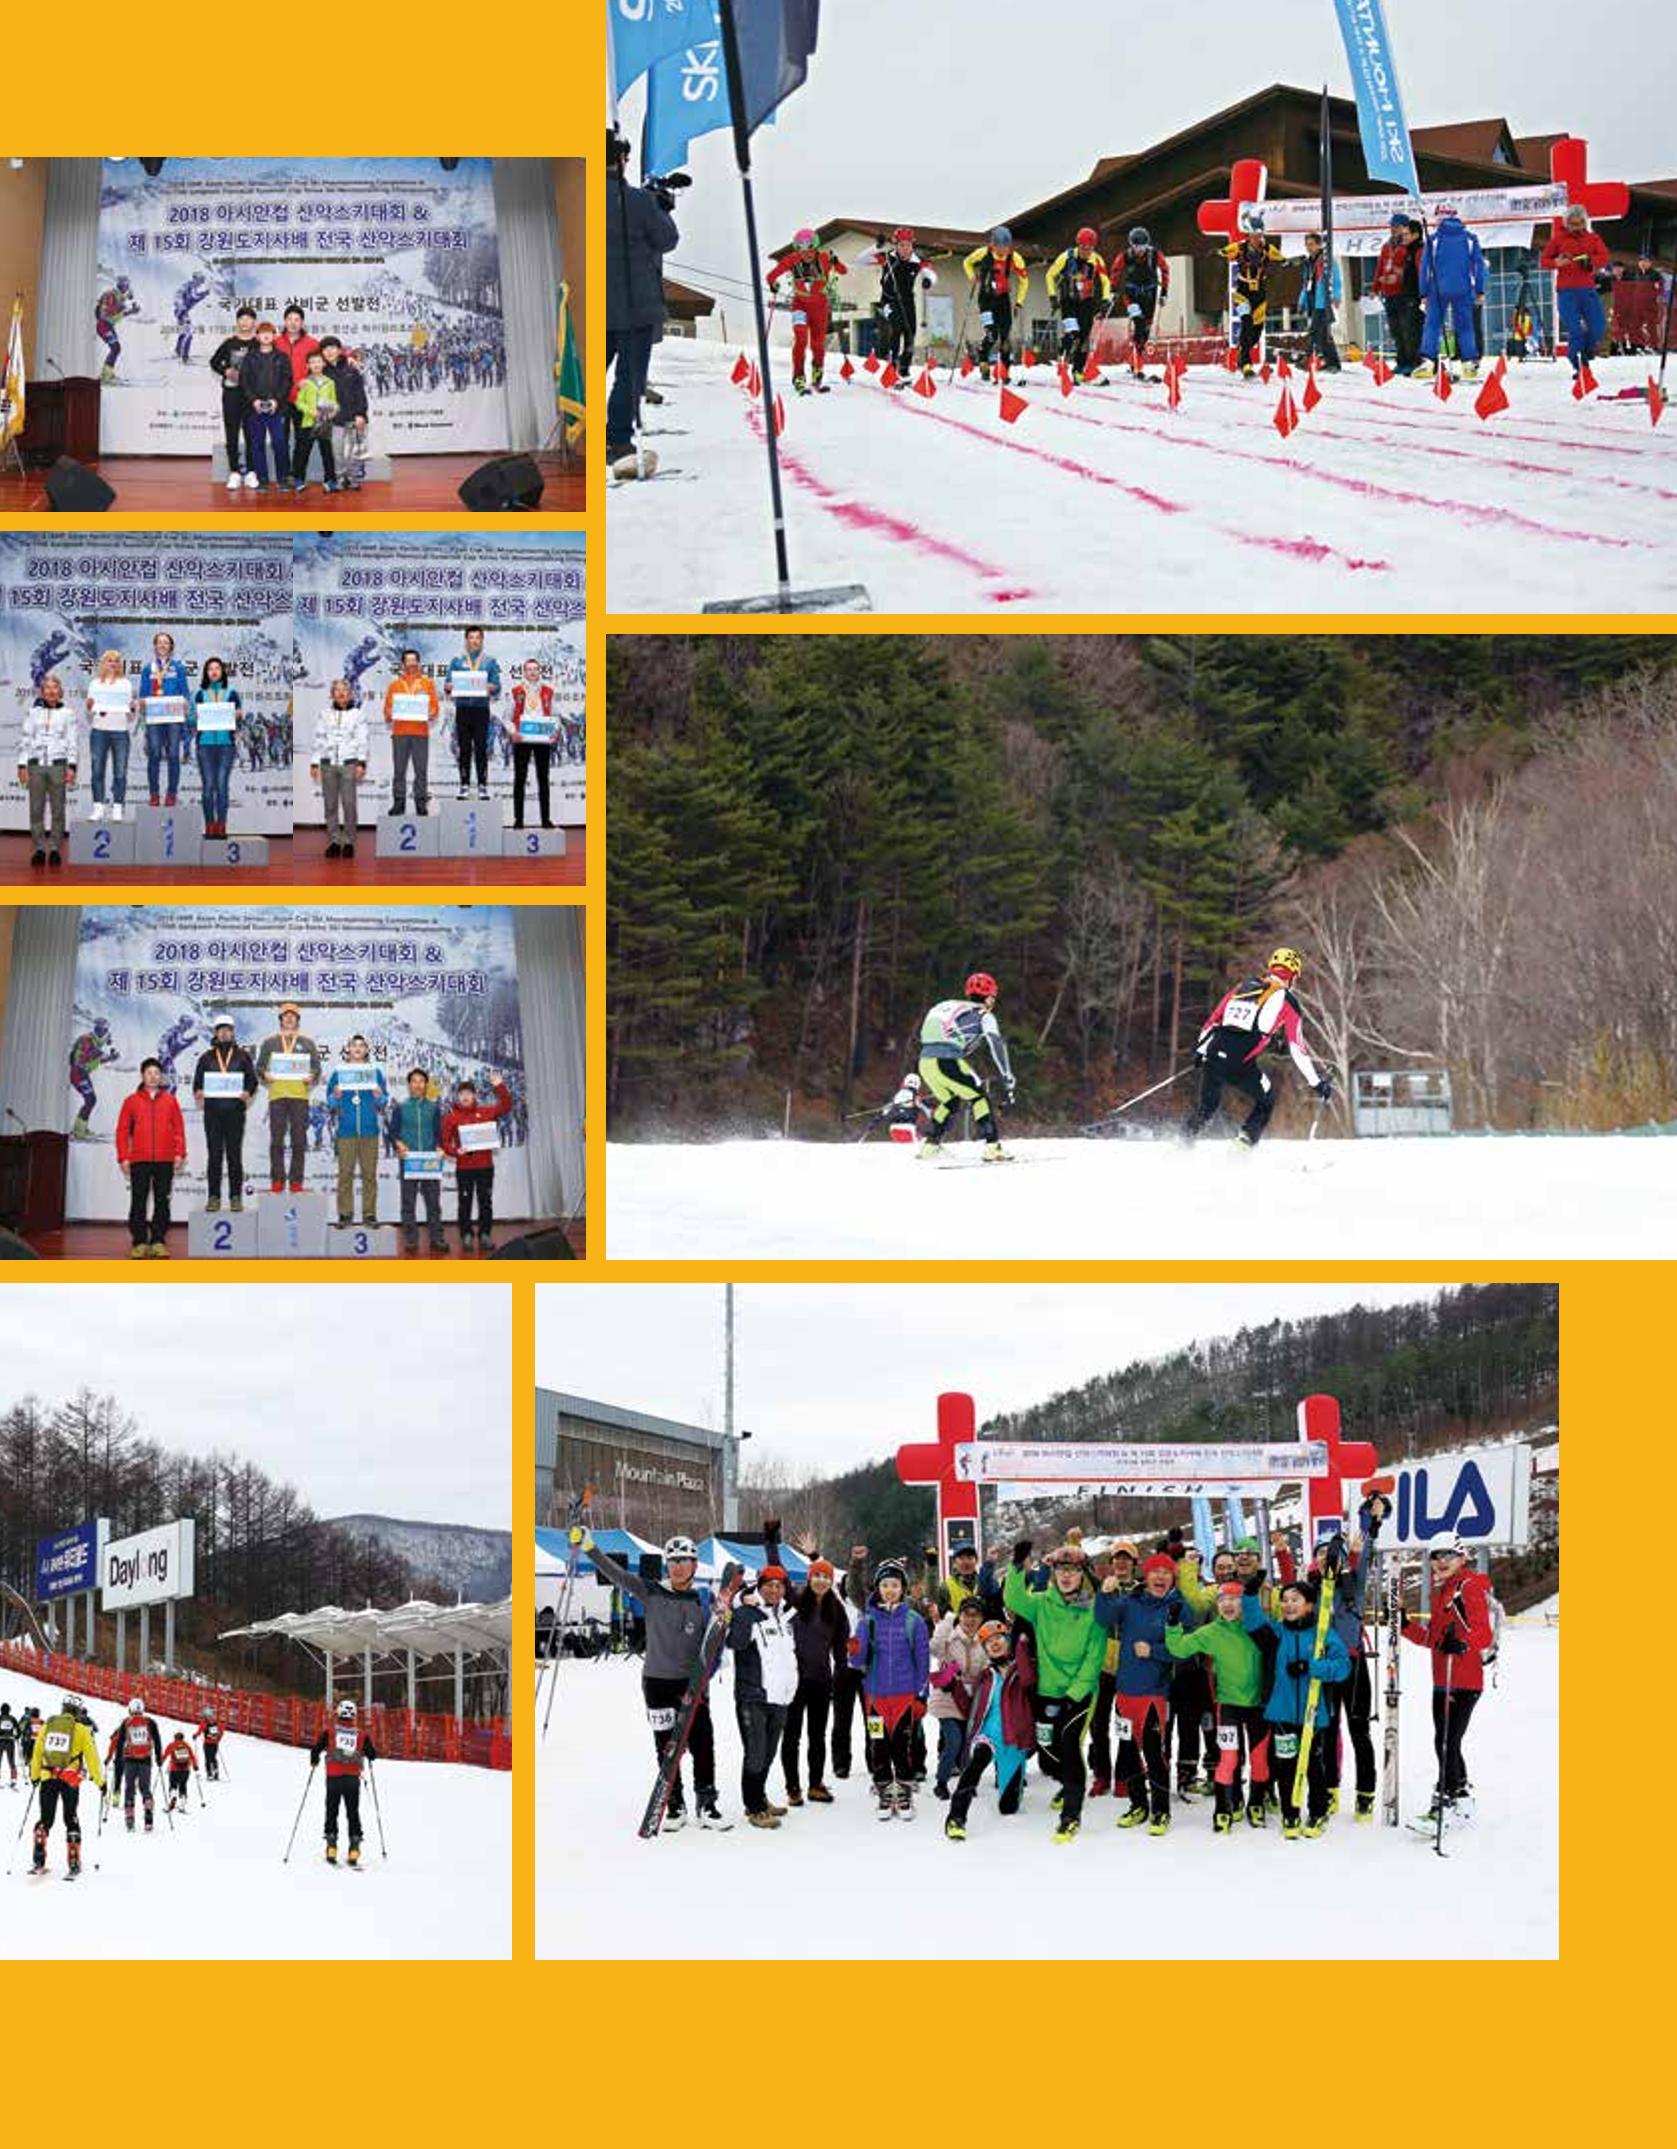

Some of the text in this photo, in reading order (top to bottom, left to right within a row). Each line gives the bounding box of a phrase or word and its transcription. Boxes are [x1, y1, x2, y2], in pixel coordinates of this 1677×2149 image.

[680, 40, 720, 101] SKI
[169, 203, 430, 222] 2018 아시안컵 산악스키대회 &
[129, 231, 468, 252] 제 15회 강원도지사배 전국 산악스키대회
[335, 296, 381, 312] 선발전
[28, 558, 283, 580] 2018 아시안컵 산악스키대회
[341, 570, 581, 590] 2018 아시안컵 산악스키대회
[11, 587, 50, 608] 15회
[58, 587, 178, 609] 강원도지사배
[186, 589, 223, 610] 전국
[300, 596, 317, 614] 제
[325, 597, 363, 614] 15회
[370, 596, 482, 616] 강원도지사배
[489, 598, 526, 617] 전국
[93, 829, 111, 859] 2
[399, 824, 417, 851] 2
[526, 834, 540, 854] 3
[227, 841, 241, 864] 3
[155, 942, 443, 962] 2018 아시안컵 산악스키대회 &
[109, 970, 486, 994] 제 15회 강원도지사배 전국 산악스키대회
[213, 1221, 232, 1250] 2
[354, 1233, 369, 1254] 3
[614, 1460, 705, 1491] Mountain Plaza
